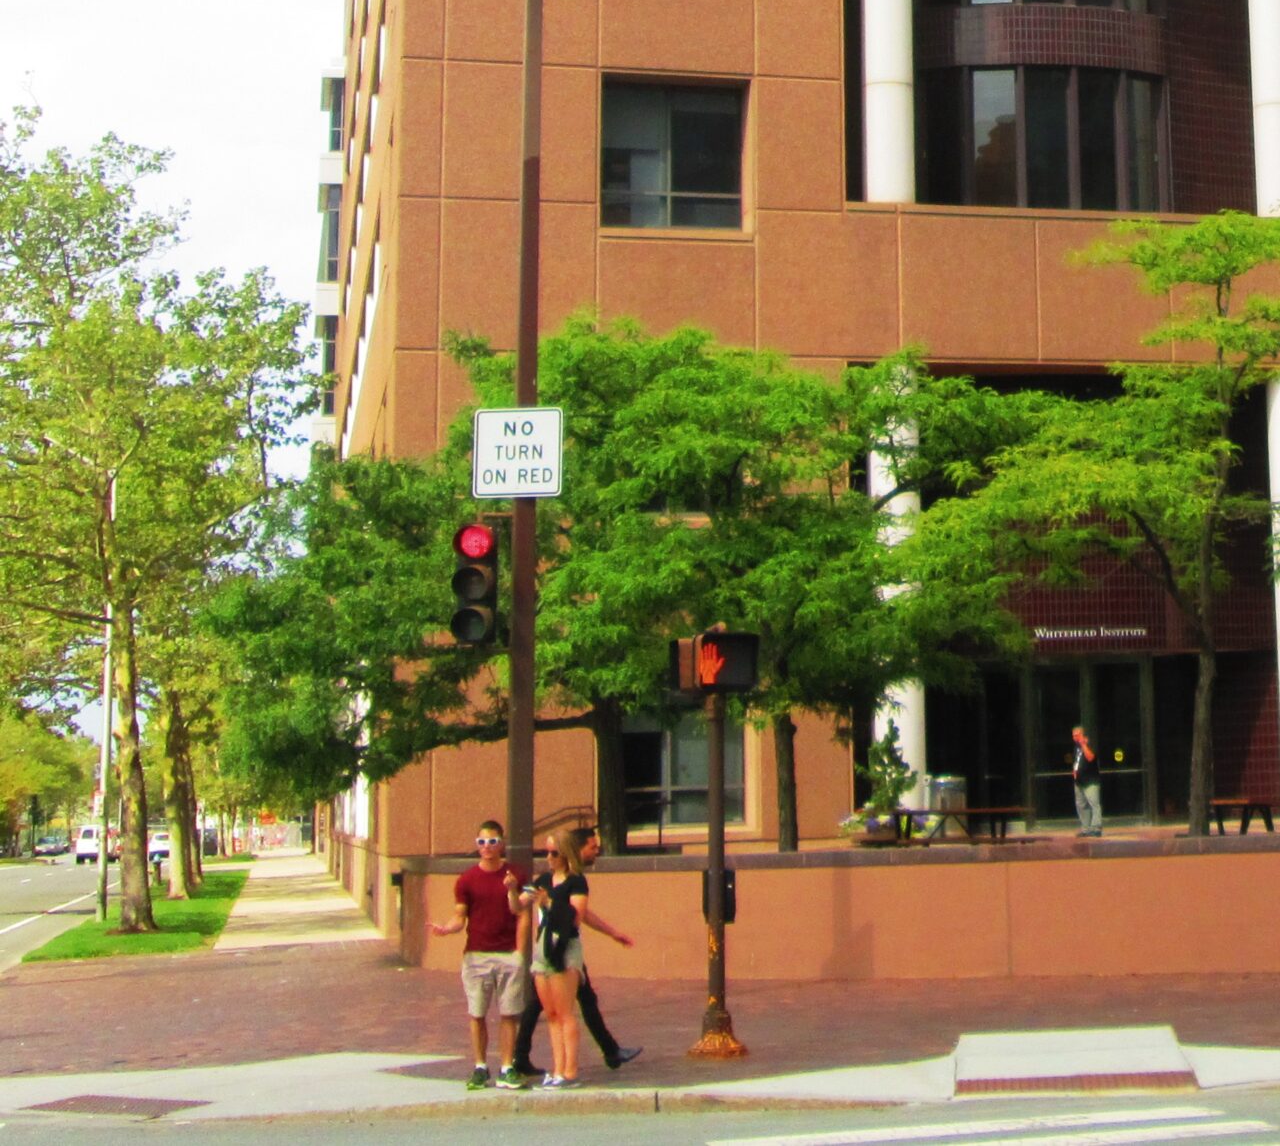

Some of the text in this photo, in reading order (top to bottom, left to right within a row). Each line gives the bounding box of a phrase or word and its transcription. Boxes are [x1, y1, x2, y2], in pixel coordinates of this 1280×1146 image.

[504, 421, 533, 436] NO
[495, 444, 543, 460] TURN
[482, 467, 553, 485] ON RED
[1034, 626, 1147, 638] WHITEHEAD INSTITUTE
